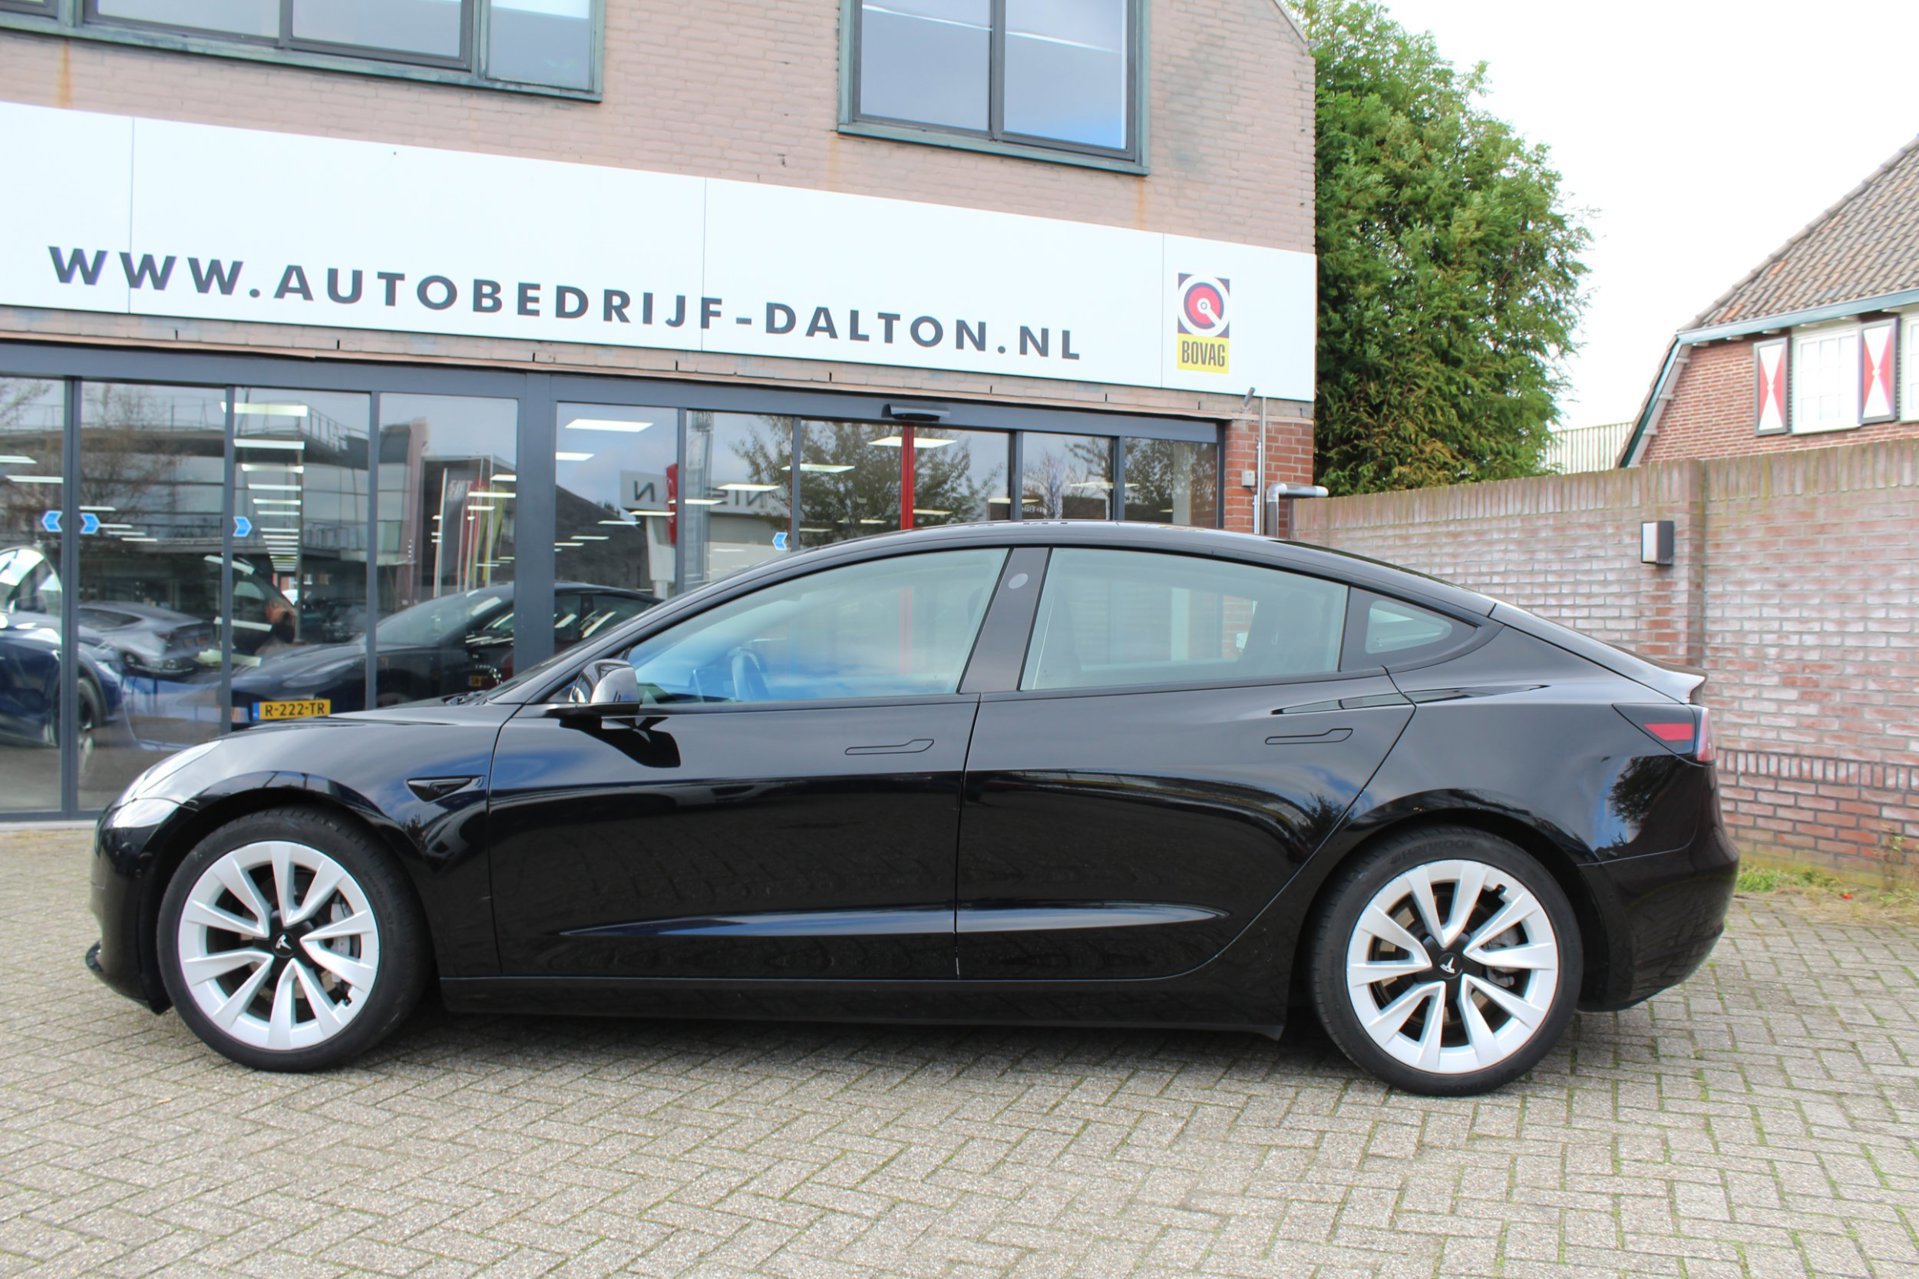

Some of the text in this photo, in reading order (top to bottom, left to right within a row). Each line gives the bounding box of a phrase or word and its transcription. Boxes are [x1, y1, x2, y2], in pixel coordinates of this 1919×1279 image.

[48, 246, 1079, 360] WWW.AUTOBEDRIJF-DALTON.NL
[1182, 340, 1225, 367] BOVAG
[265, 702, 325, 717] R-222-TR
